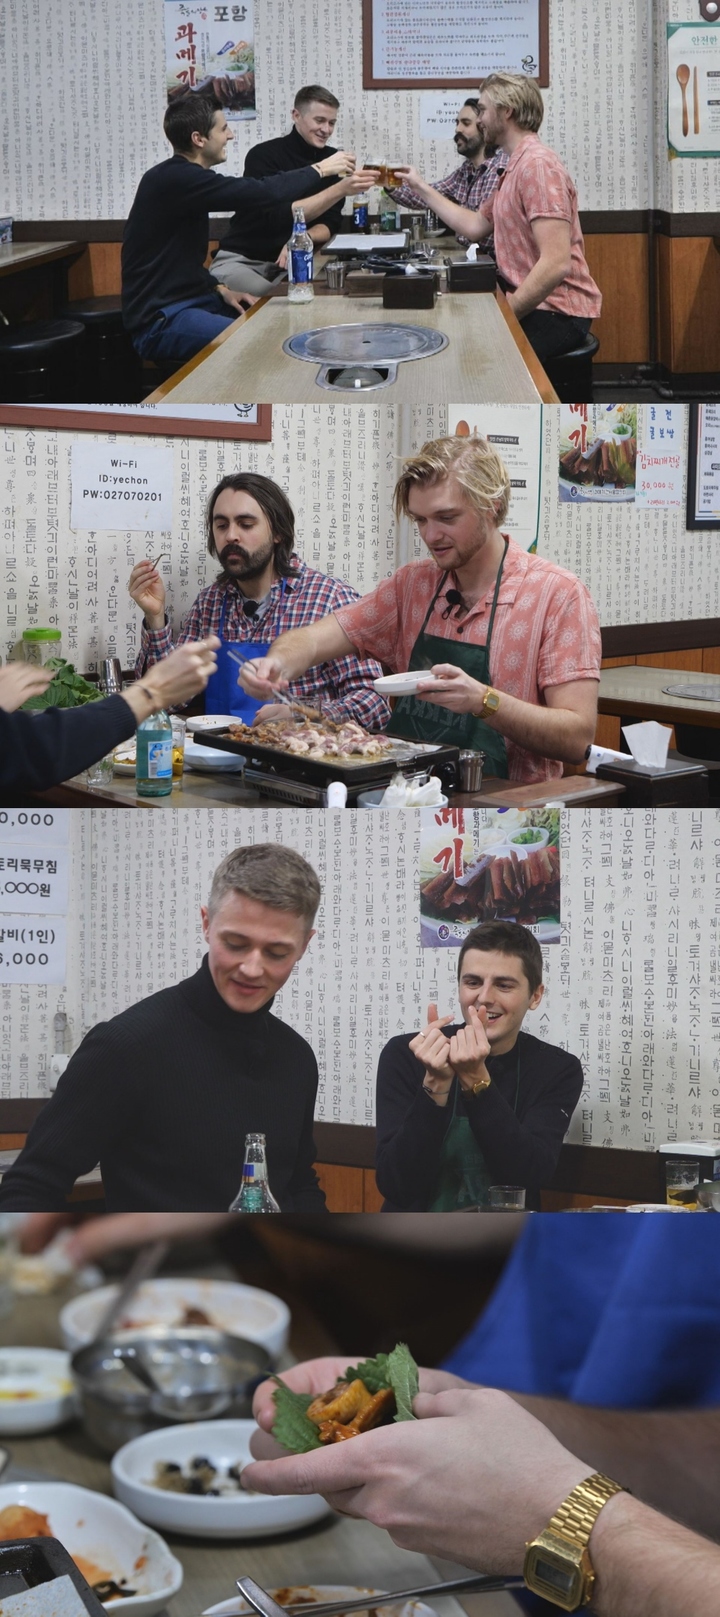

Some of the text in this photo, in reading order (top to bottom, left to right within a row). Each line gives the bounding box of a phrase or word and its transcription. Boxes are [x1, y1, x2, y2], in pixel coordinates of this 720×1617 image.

[213, 5, 248, 22] 포항
[691, 35, 718, 46] 안전한
[174, 22, 197, 87] 과메기
[110, 458, 138, 469] Wi-Fi
[98, 474, 149, 486] ID:yechon
[82, 490, 163, 502] PW:027070201
